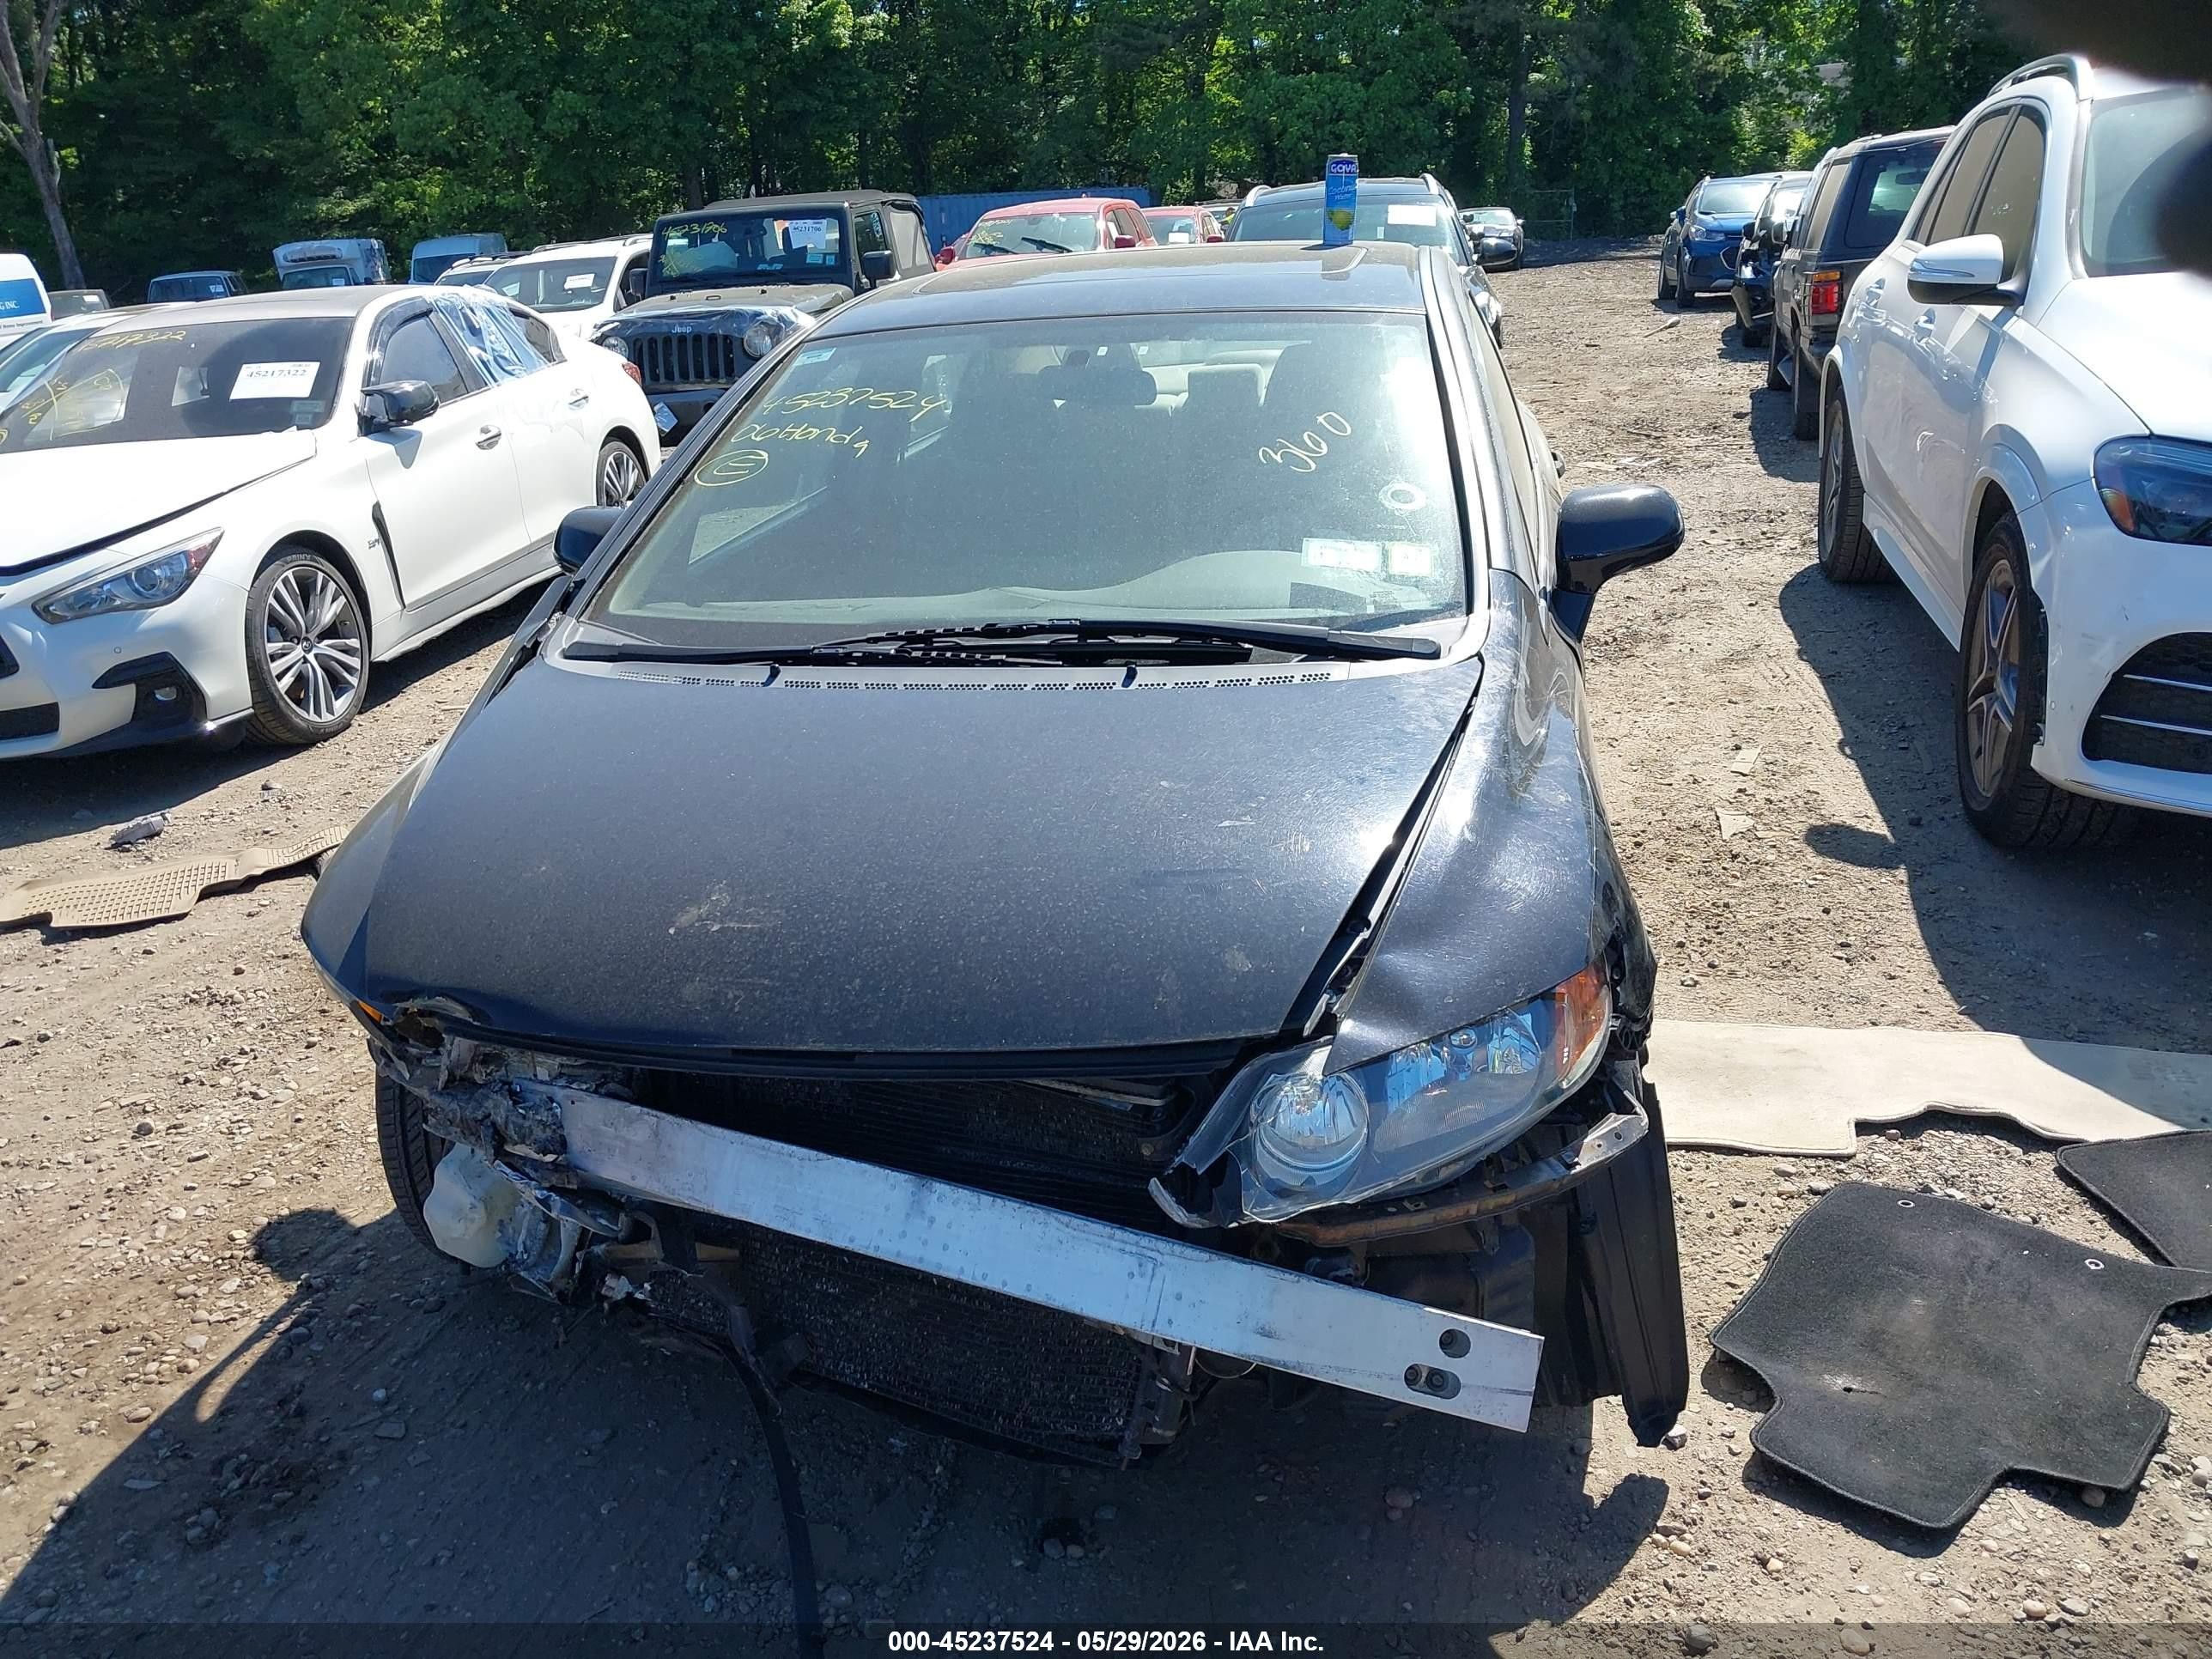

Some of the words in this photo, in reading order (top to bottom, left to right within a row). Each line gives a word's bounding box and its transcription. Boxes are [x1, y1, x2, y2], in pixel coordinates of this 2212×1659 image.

[1331, 164, 1357, 173] GOYA
[672, 324, 693, 334] Jeep
[246, 368, 307, 378] 45217322
[1258, 411, 1352, 472] 360
